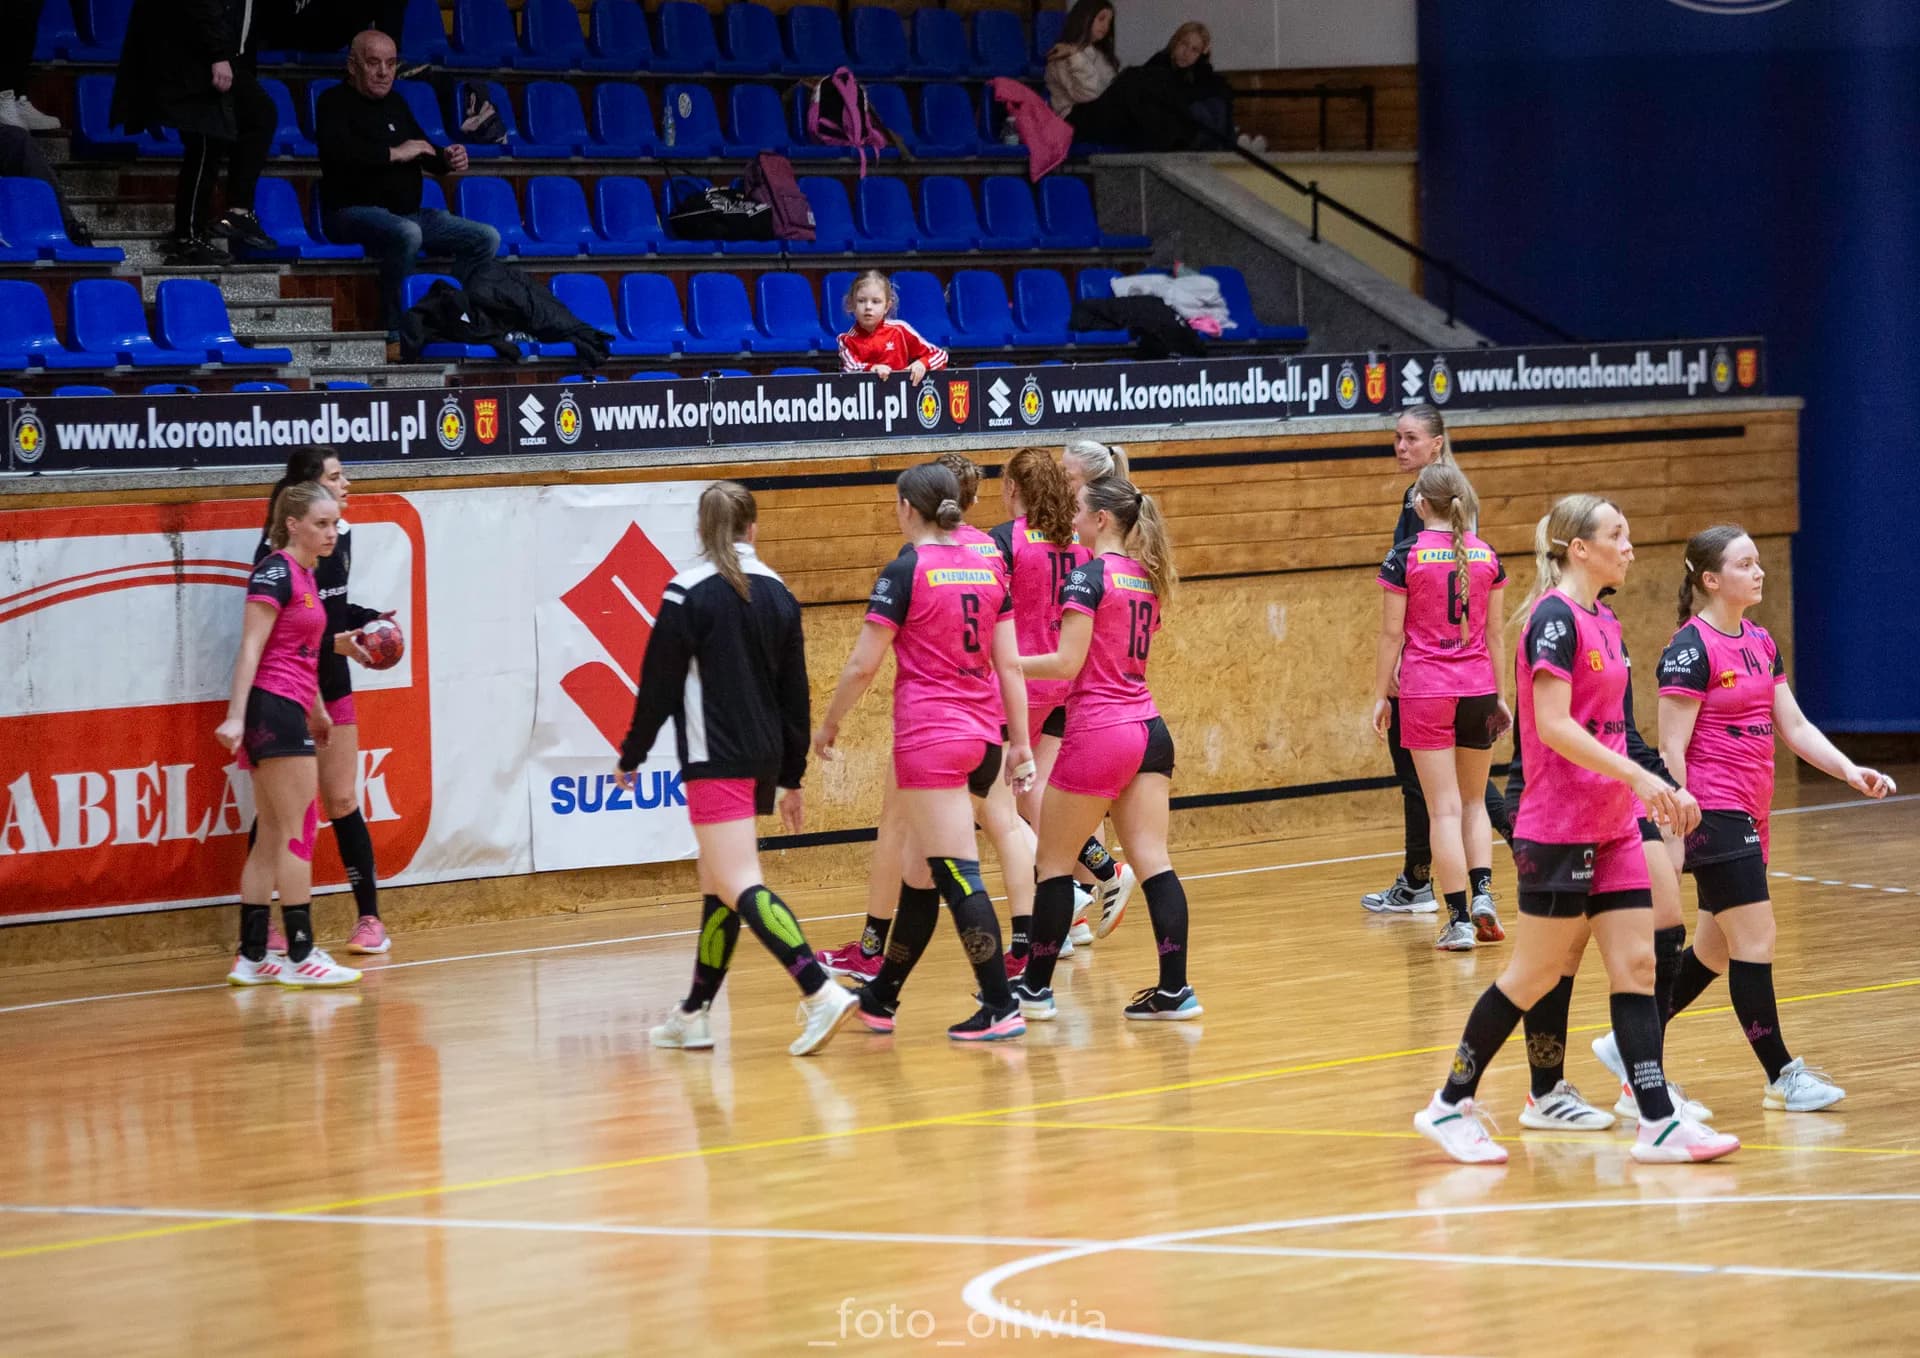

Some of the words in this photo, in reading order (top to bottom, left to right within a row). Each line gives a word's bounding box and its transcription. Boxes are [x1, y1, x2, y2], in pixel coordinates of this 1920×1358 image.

[1051, 363, 1330, 413] www.koronahandball.pl
[1457, 348, 1708, 395] www.koronahandball.pl
[55, 400, 427, 454] www.koronahandball.pl
[477, 417, 495, 439] CK
[590, 380, 908, 432] www.koronahandball.pl
[950, 401, 967, 419] CK
[988, 418, 1013, 427] SUZUKI
[520, 437, 547, 446] SUZUKI
[961, 594, 981, 653] 5
[1128, 599, 1153, 660] 13
[1739, 647, 1762, 676] 14
[0, 748, 402, 856] ABELAK
[550, 770, 688, 815] SUZUK
